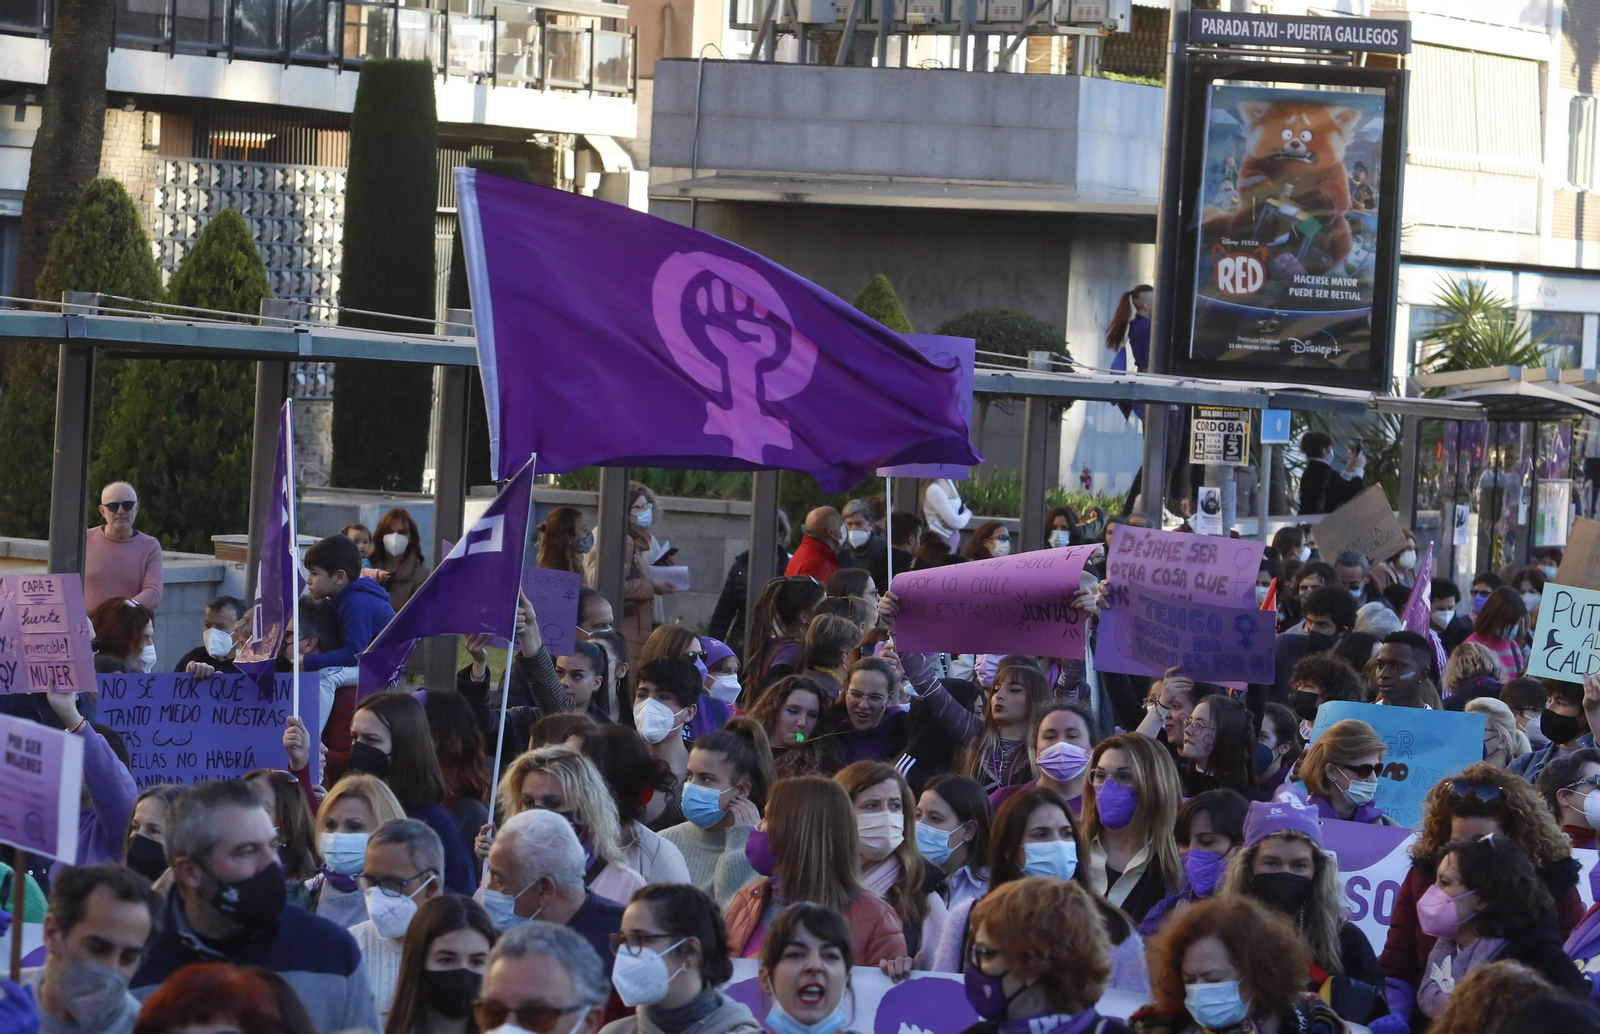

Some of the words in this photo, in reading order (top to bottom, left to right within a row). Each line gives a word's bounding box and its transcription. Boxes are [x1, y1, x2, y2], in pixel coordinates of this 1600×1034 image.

[1201, 17, 1249, 36] PARADA
[1252, 21, 1278, 38] TAXI
[1287, 23, 1332, 41] PUERTA
[1335, 26, 1398, 45] GALLEGOS
[1241, 239, 1260, 247] PIXAR
[1217, 255, 1264, 294] RED
[1293, 274, 1330, 286] HACERSE
[1331, 277, 1358, 287] MAYOR
[1289, 288, 1314, 298] PUEDE
[1315, 289, 1329, 299] SER
[1331, 290, 1361, 301] BESTIAL
[1196, 421, 1243, 433] CORDOBA
[1226, 441, 1238, 455] 3
[1016, 557, 1056, 569] sola
[1185, 541, 1218, 565] SER
[1110, 561, 1146, 583] OTRA
[1151, 567, 1188, 589] COSA
[1194, 571, 1229, 596] QUE
[936, 602, 1015, 621] ESTAMOS
[1022, 601, 1079, 625] JUNTAS
[1138, 593, 1223, 637] TENGO
[1552, 591, 1600, 630] PUT
[29, 662, 74, 687] MUJER
[1213, 653, 1246, 674] POR
[101, 678, 127, 700] NO
[173, 677, 200, 700] POR
[103, 705, 151, 727] TANTO
[159, 703, 201, 723] MIEDO
[212, 706, 286, 728] NUESTRAS
[131, 752, 167, 770] ELLAS
[176, 752, 198, 769] NO
